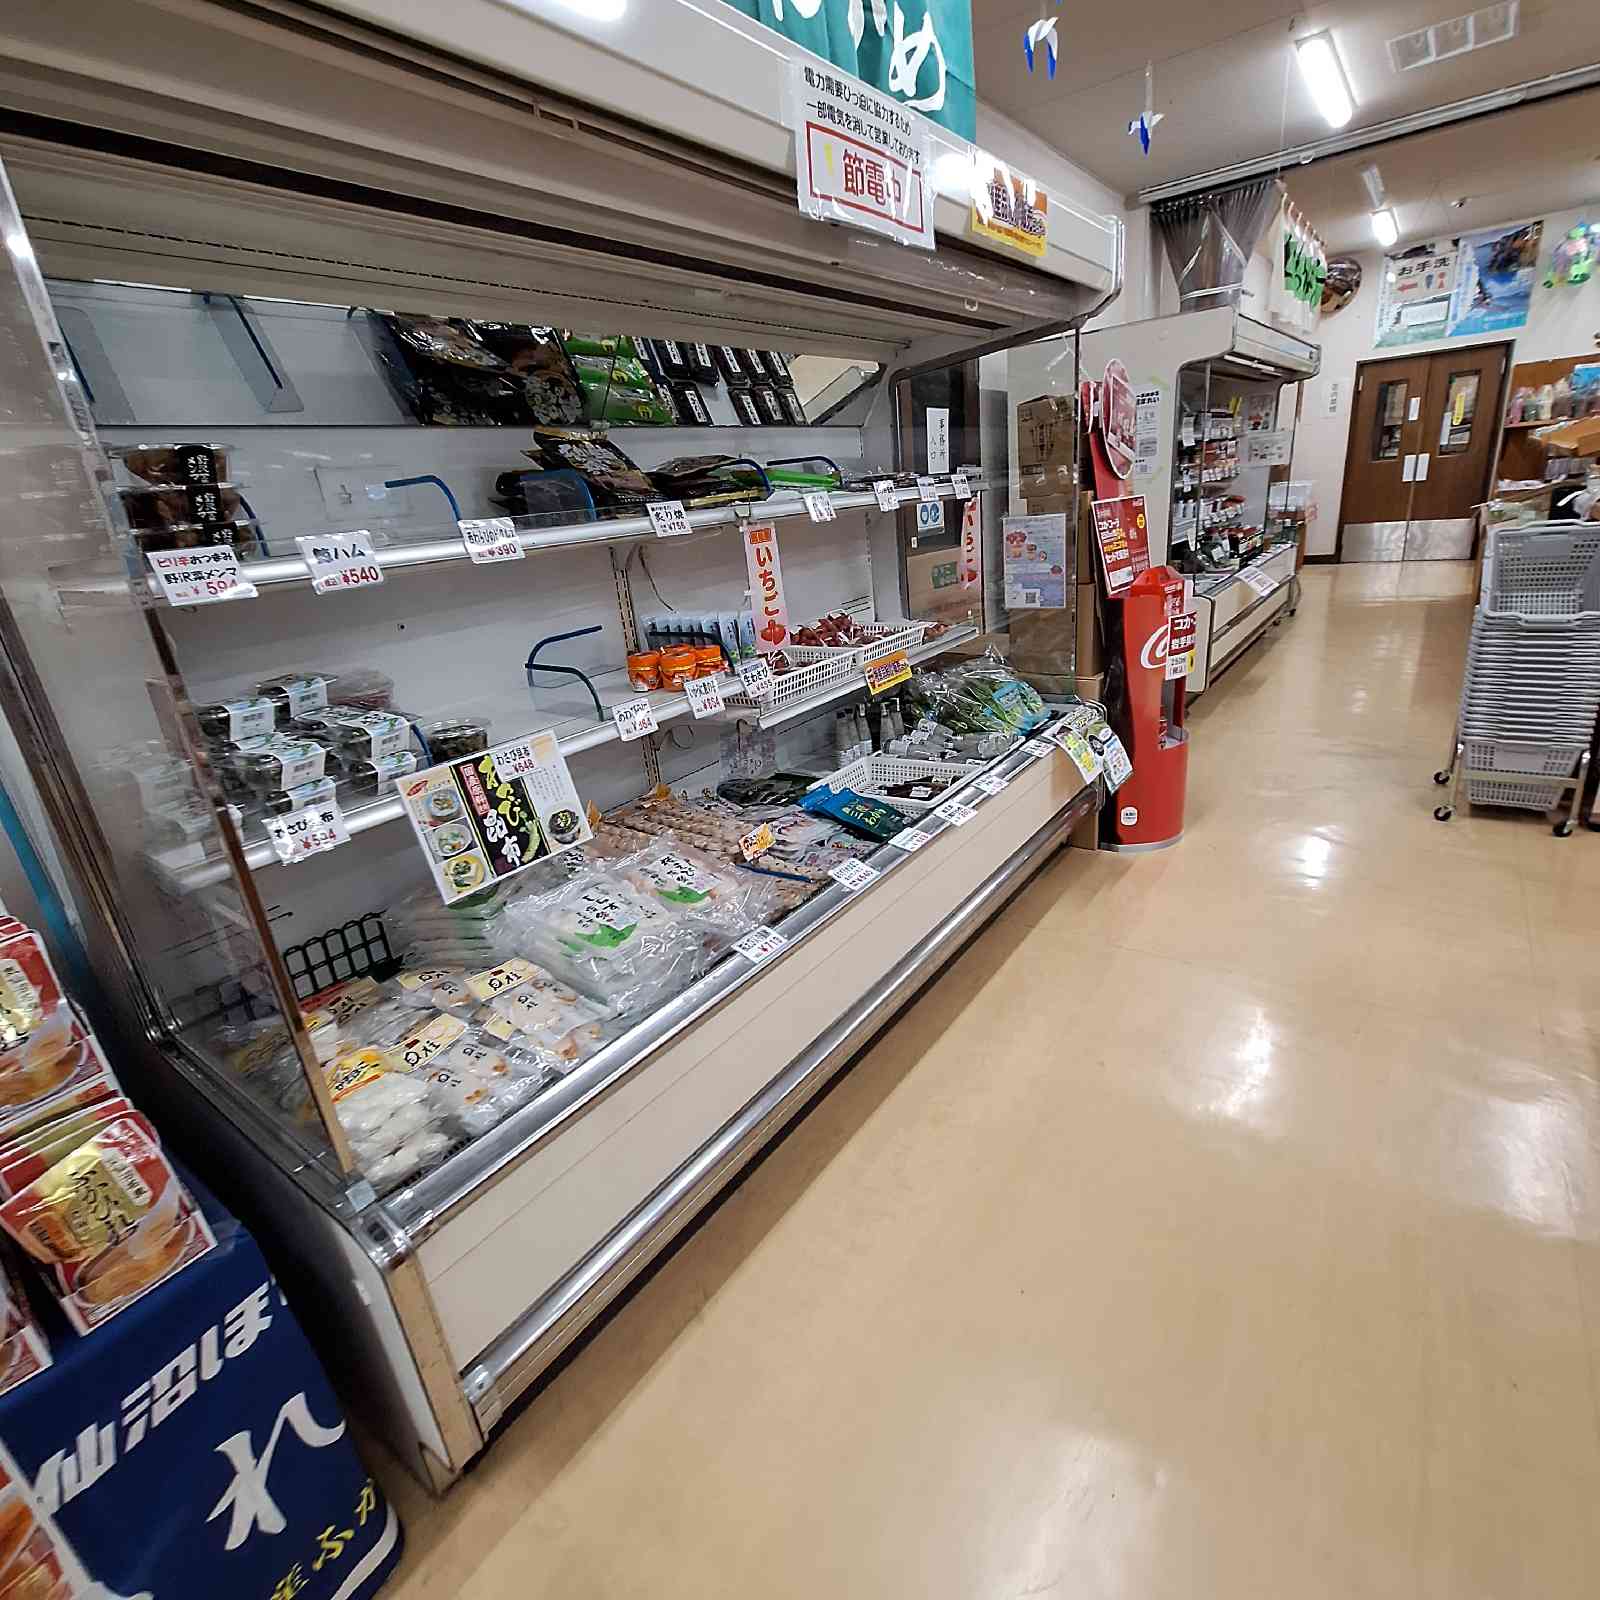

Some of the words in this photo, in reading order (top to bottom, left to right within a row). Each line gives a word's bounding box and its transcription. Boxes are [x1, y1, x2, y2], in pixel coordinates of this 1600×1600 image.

[157, 552, 233, 568] ピリ辛おつまみ
[35, 1275, 288, 1513] 仙沼ほ
